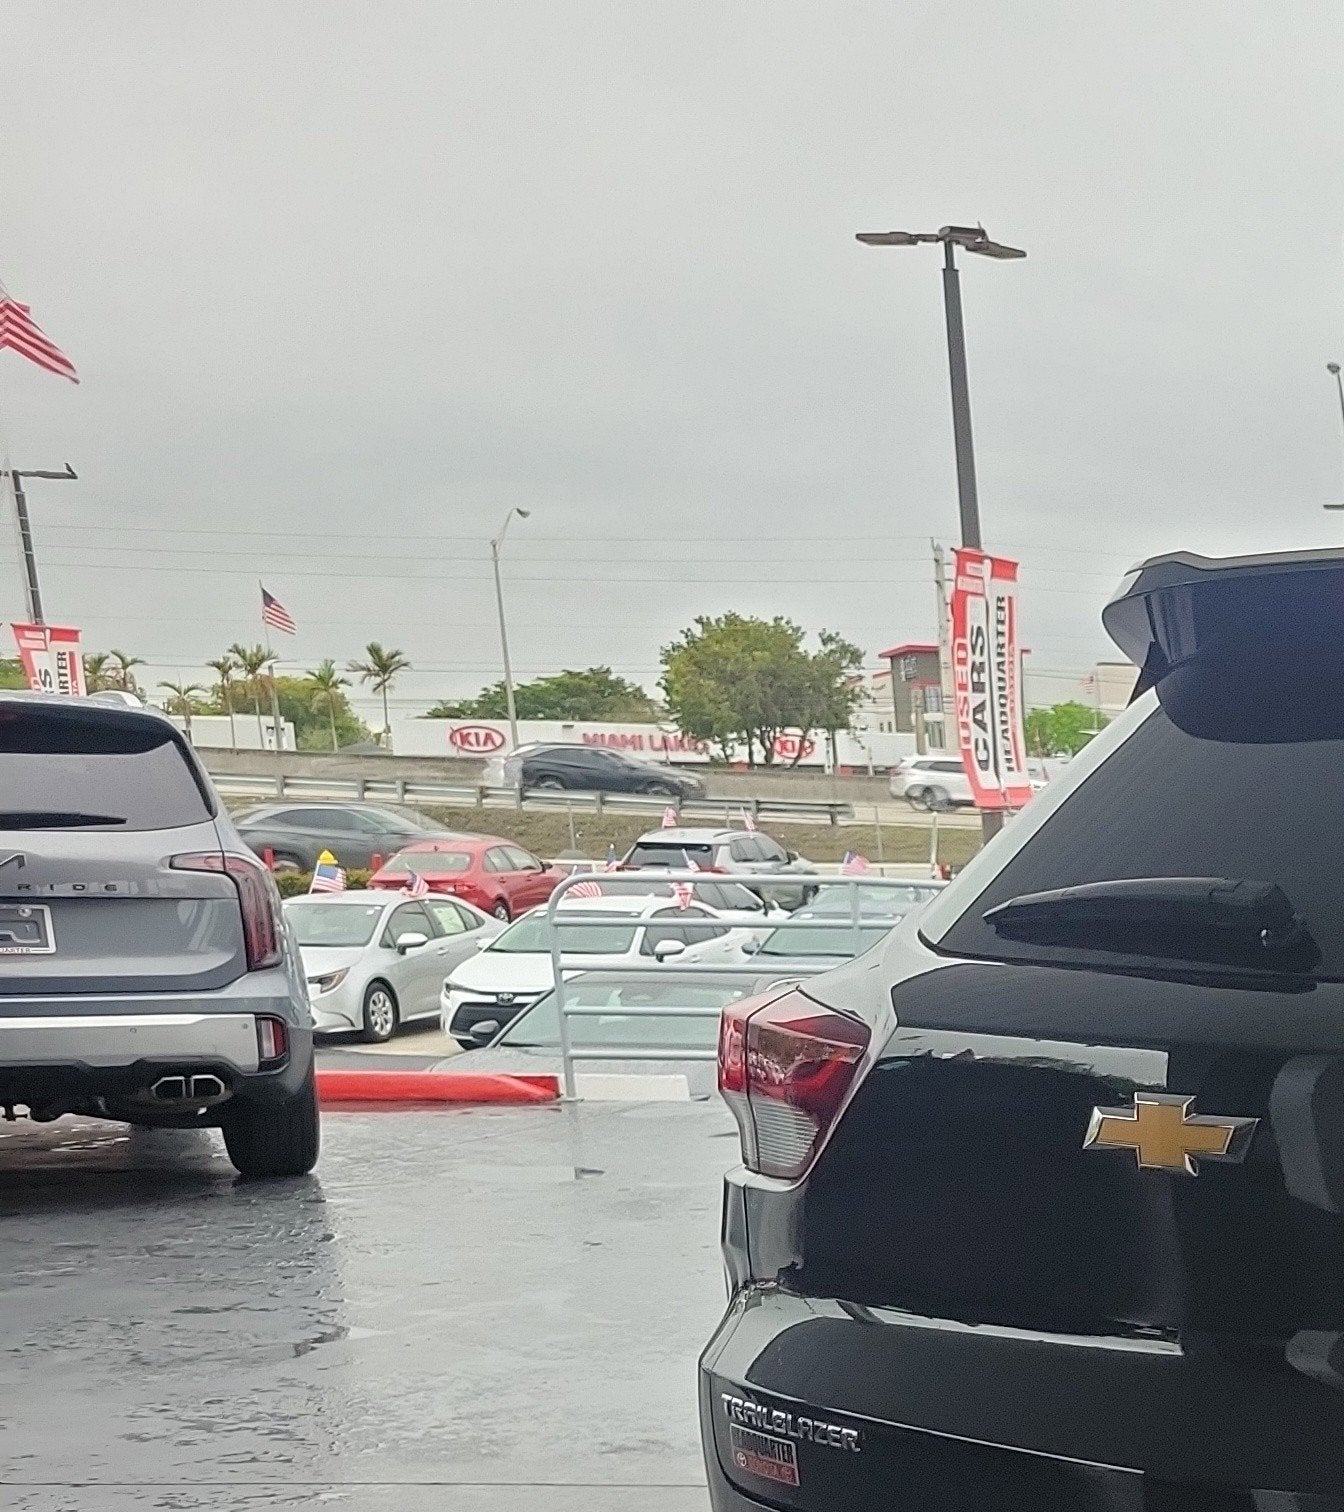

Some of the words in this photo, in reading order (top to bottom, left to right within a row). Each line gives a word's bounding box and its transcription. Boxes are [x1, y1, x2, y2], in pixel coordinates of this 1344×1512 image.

[956, 642, 971, 748] USED
[971, 626, 989, 772] CARS
[996, 596, 1015, 772] HEADQUARTER
[459, 732, 497, 747] KIA
[582, 733, 643, 751] MIAMI
[721, 1393, 861, 1452] TRAILBLAZER
